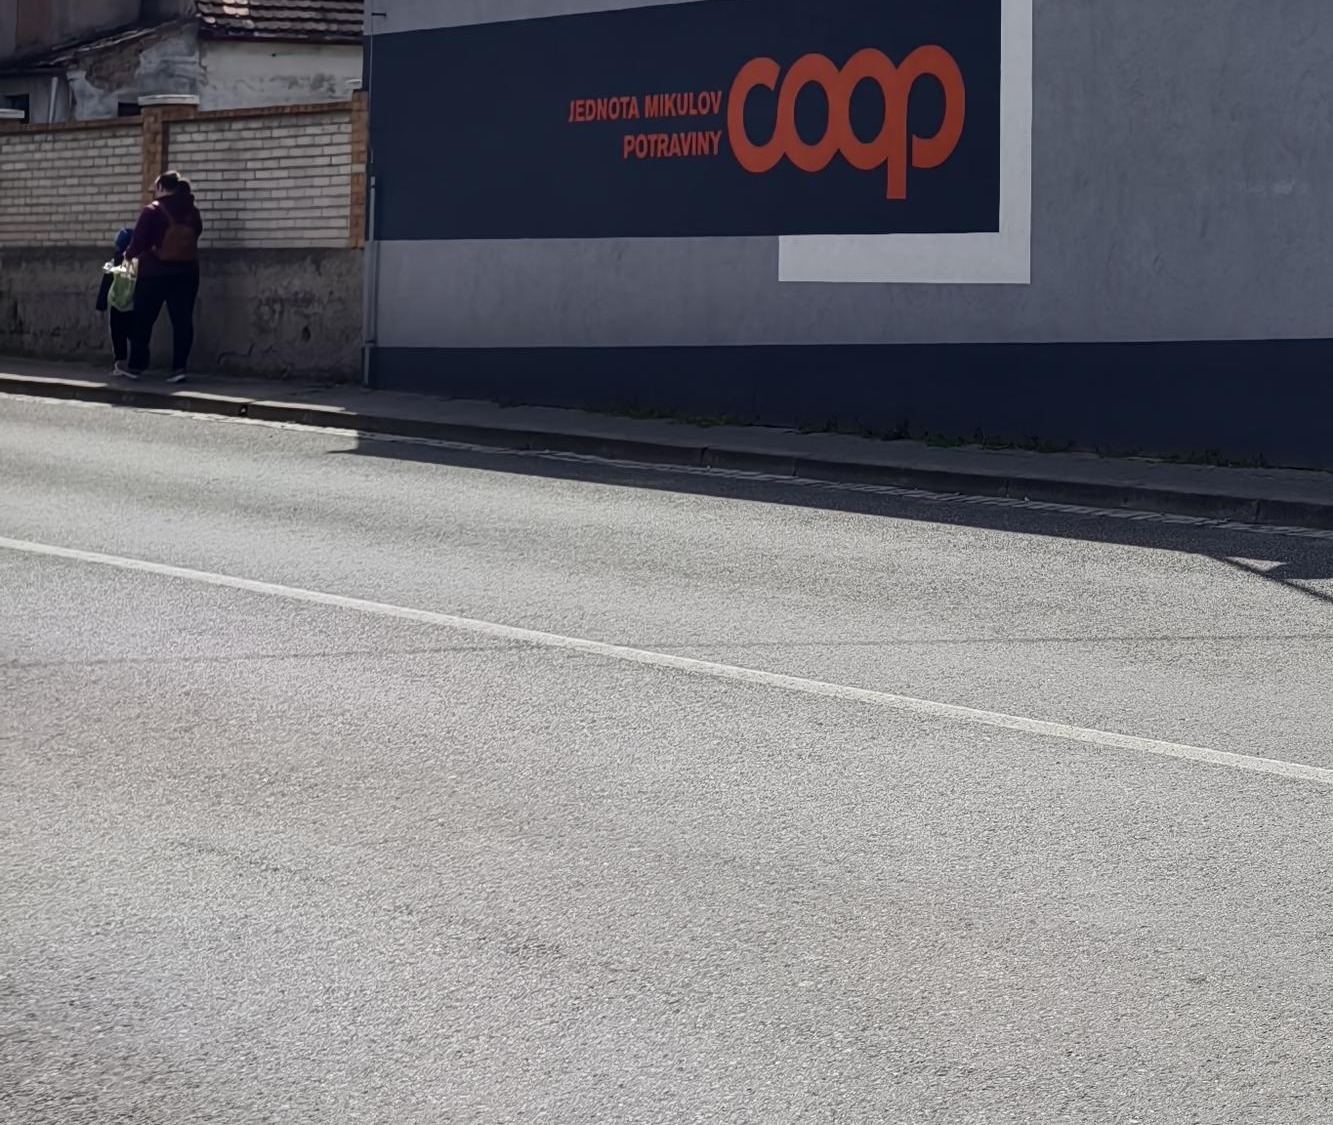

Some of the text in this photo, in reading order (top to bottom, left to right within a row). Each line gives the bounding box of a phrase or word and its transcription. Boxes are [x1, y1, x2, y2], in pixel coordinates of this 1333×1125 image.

[568, 90, 723, 123] JEDNOTA MIKULOV
[727, 44, 966, 200] coop
[623, 130, 722, 160] POTRAVINY
